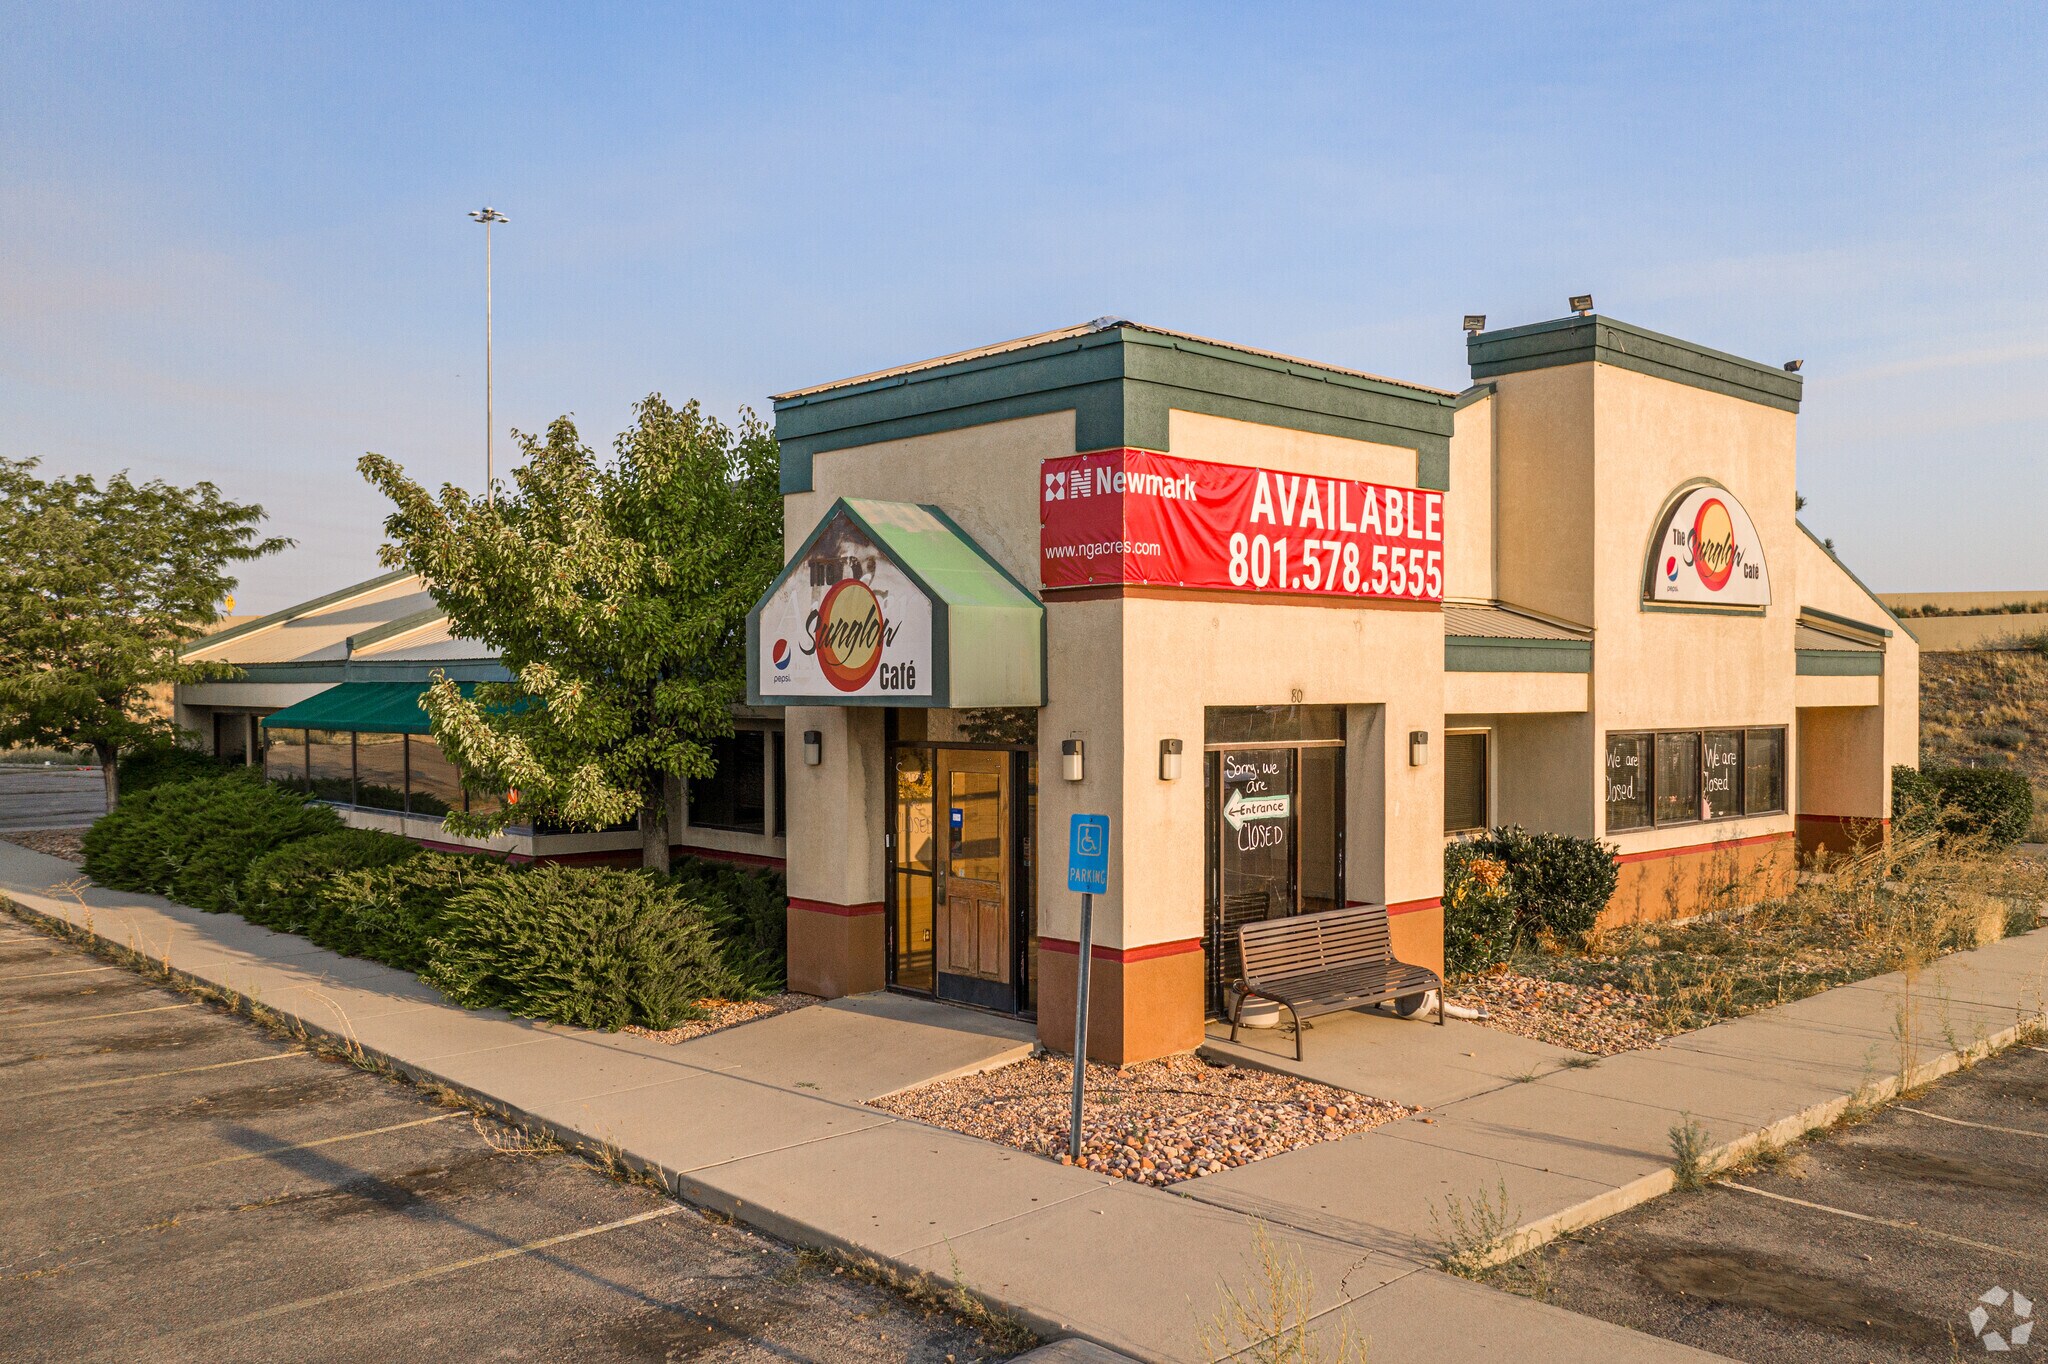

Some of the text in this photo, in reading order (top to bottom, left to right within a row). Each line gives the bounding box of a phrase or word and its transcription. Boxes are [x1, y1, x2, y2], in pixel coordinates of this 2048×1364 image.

[1096, 466, 1198, 502] Newmark
[1249, 472, 1442, 541] AVAILABLE
[1045, 540, 1161, 560] www.ngacres.com
[1672, 527, 1759, 580] The Sunglow Café
[1229, 532, 1442, 598] 801.578.5555
[799, 603, 903, 667] Sunglow
[773, 673, 792, 684] pepsi
[879, 659, 916, 690] Café
[1291, 688, 1303, 703] 80
[1606, 747, 1638, 768] We are
[1704, 743, 1737, 769] We are
[1262, 763, 1279, 775] we
[1246, 780, 1268, 794] are
[1240, 801, 1284, 816] Entrance
[1238, 822, 1283, 851] CLOSED
[1069, 867, 1106, 885] PARKING
